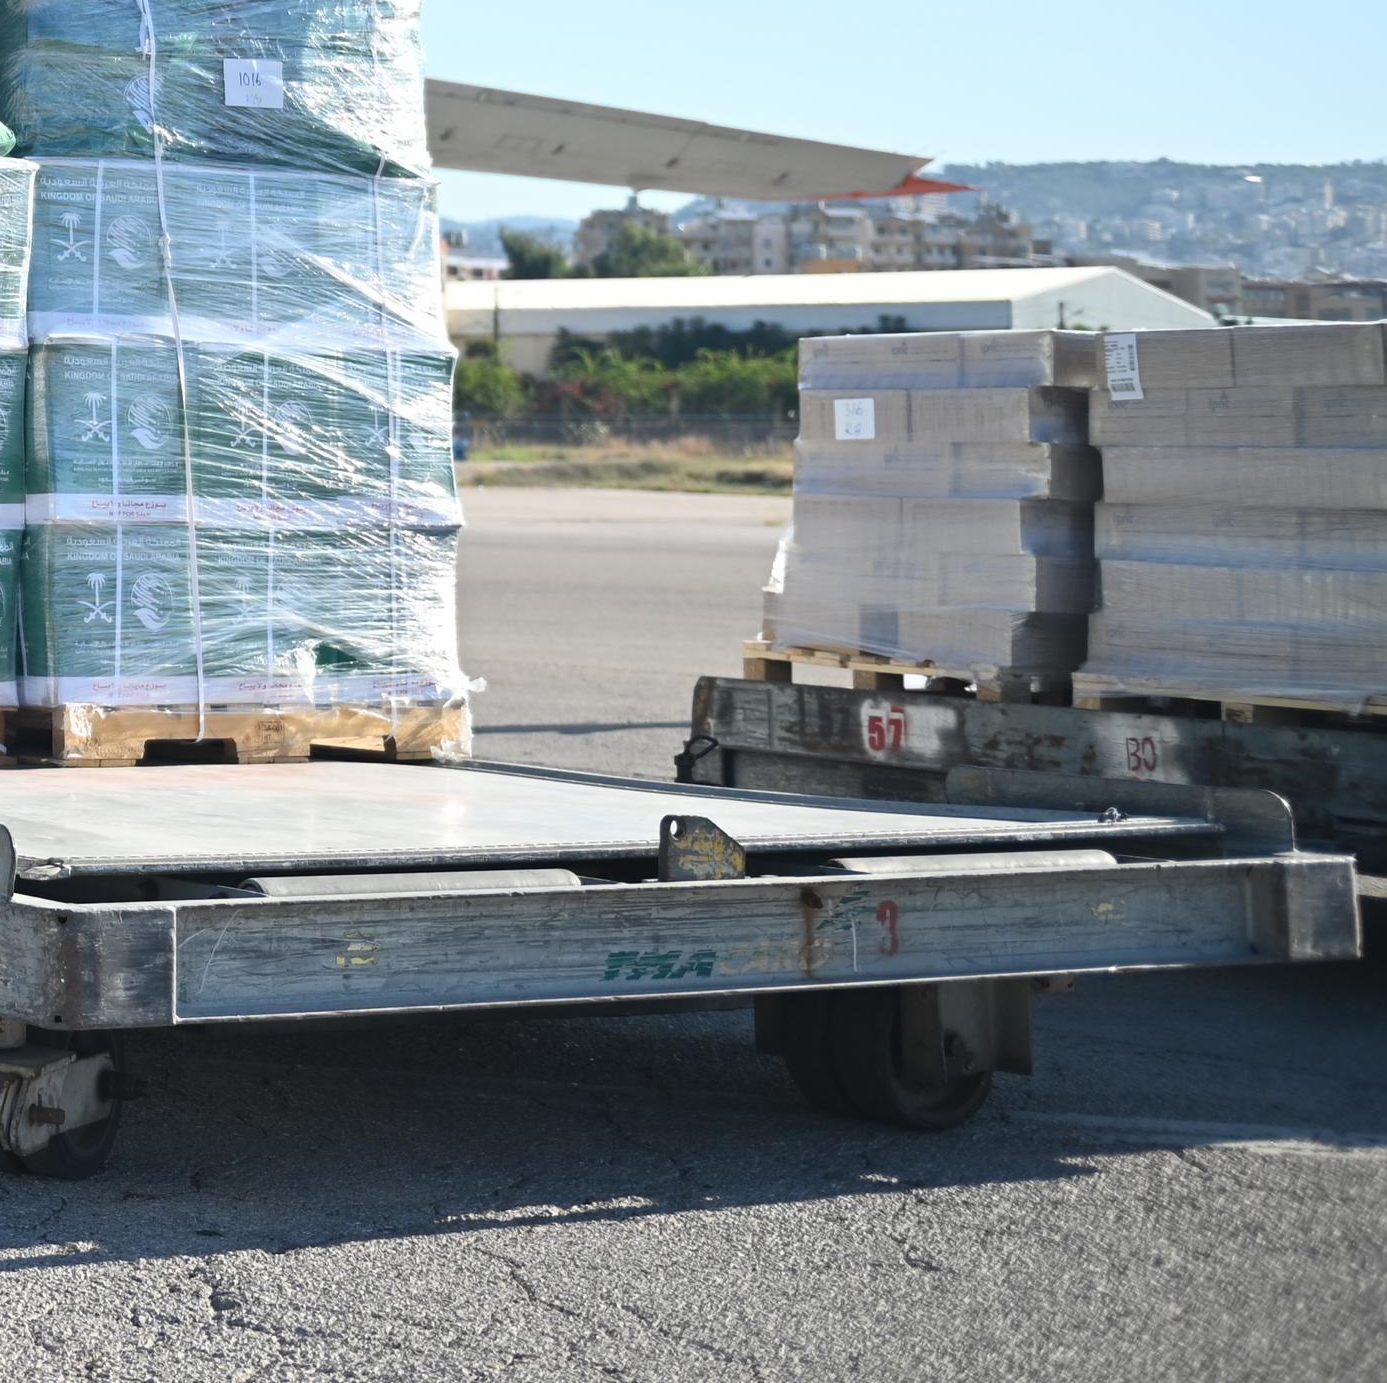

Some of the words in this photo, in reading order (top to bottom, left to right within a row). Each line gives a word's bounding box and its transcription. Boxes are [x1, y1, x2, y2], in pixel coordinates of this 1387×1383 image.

[239, 72, 262, 86] 1016
[40, 191, 83, 201] KINGDOM
[67, 551, 107, 561] KINGDOM
